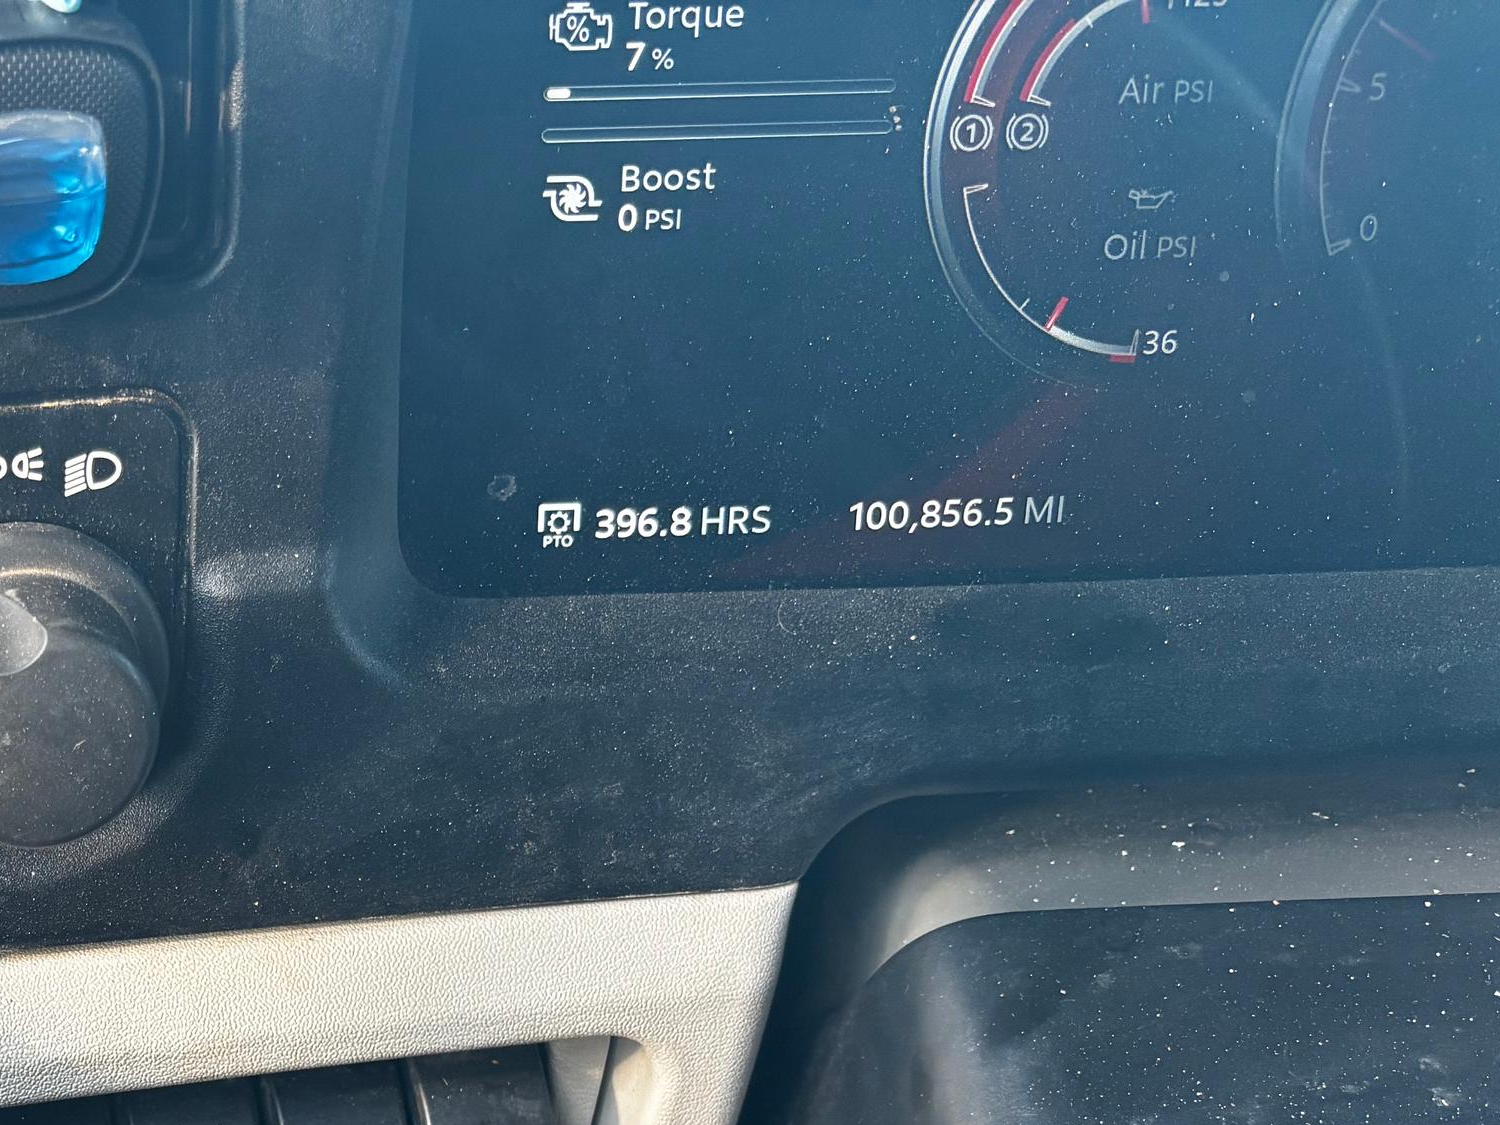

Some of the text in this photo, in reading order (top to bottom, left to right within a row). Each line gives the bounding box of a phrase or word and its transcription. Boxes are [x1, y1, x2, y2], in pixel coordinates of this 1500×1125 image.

[628, 1, 744, 38] Torque
[626, 42, 674, 71] 7 %
[1119, 75, 1213, 104] Air PSI
[1369, 72, 1388, 101] 5
[621, 162, 716, 192] Boost
[618, 203, 682, 232] 0 PSI
[1360, 215, 1378, 242] 0
[1104, 230, 1196, 260] Oil PSI
[1143, 330, 1178, 355] 36
[595, 506, 771, 539] 396.8 HRS
[849, 496, 1065, 535] 100,856.5 MI
[542, 535, 574, 548] PTO
